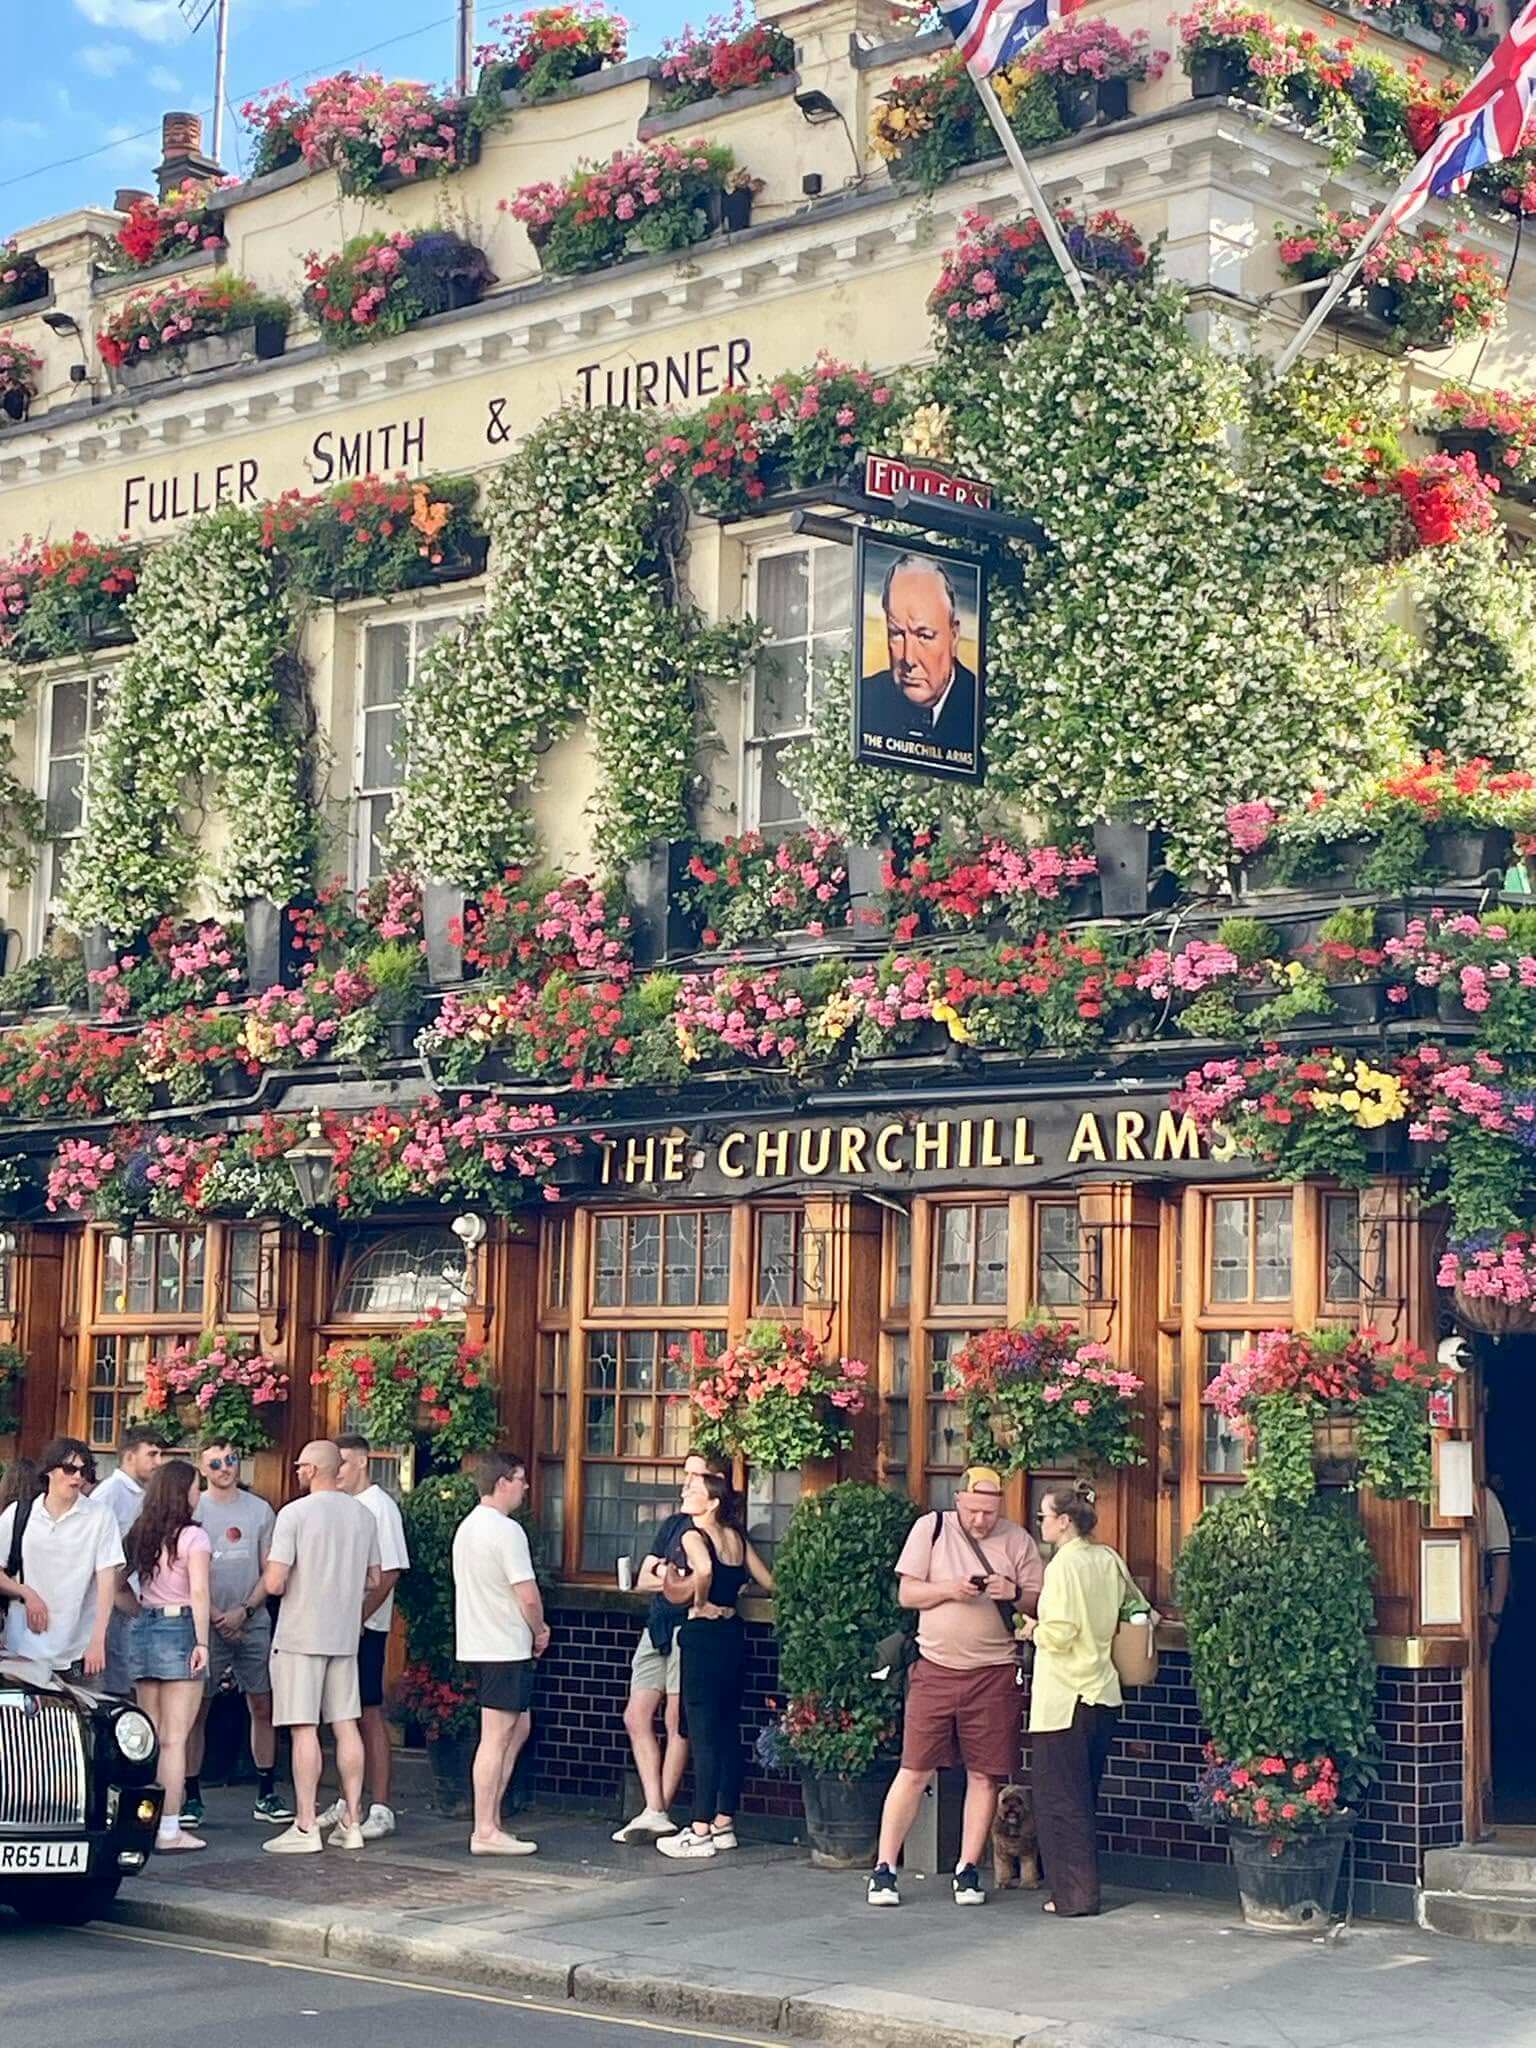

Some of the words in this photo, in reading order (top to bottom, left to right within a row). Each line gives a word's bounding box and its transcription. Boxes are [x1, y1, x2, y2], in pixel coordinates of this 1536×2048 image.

[123, 458, 259, 529] FULLER
[311, 416, 425, 484] SMITH
[486, 398, 511, 445] &
[576, 338, 751, 412] TURNER
[862, 732, 883, 749] THE
[885, 737, 944, 760] CHURCHILL
[945, 749, 973, 765] ARMS
[601, 1135, 685, 1185] THE
[717, 1115, 1036, 1178] CHURCHILL
[45, 1845, 79, 1867] LLA
